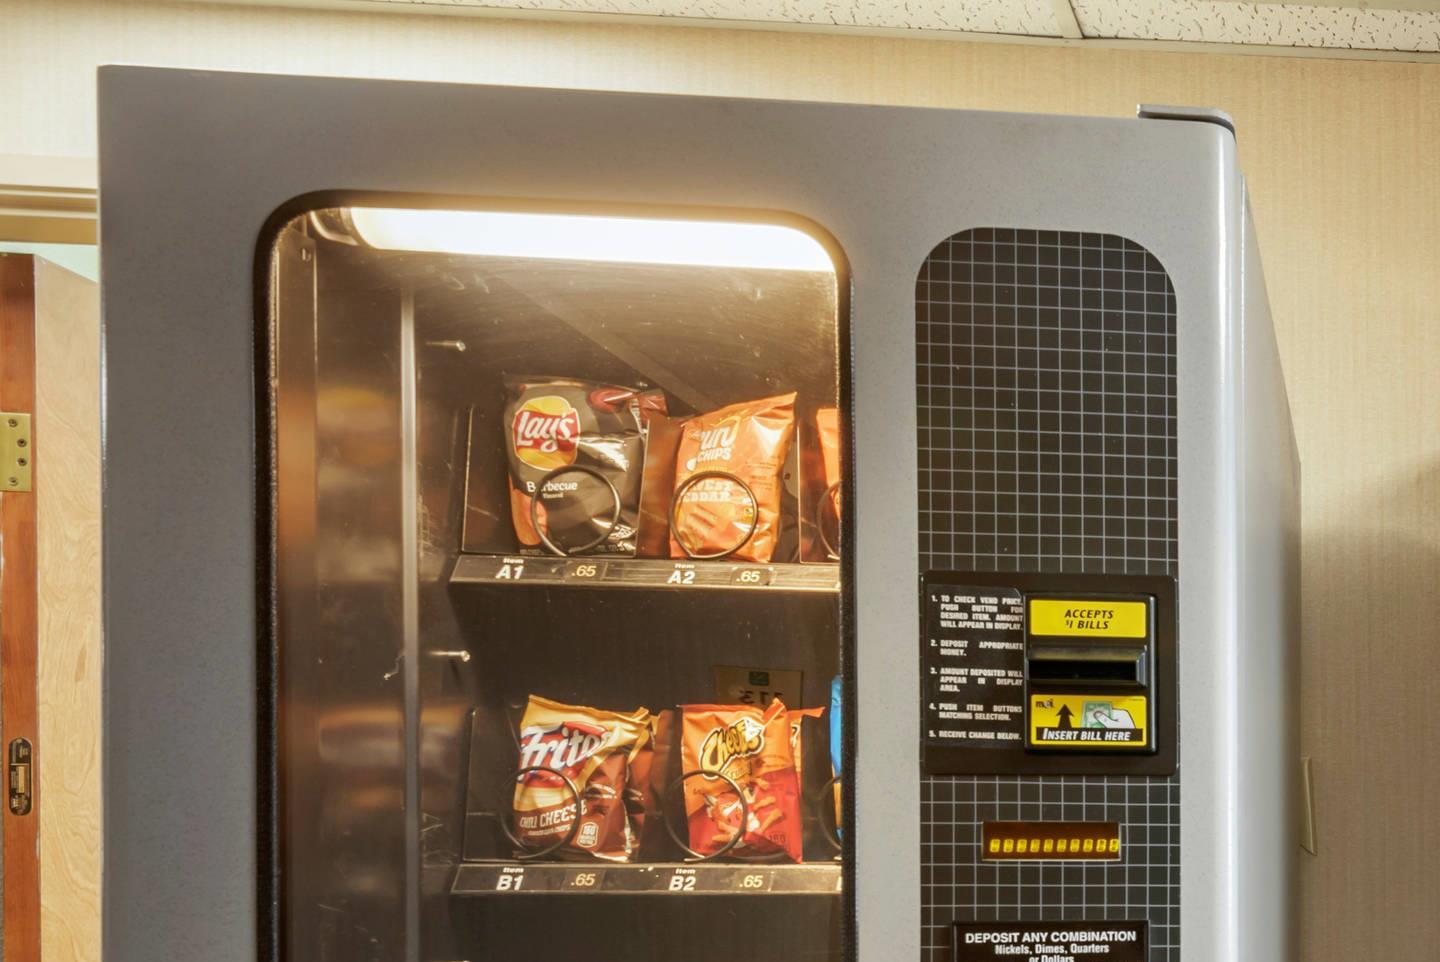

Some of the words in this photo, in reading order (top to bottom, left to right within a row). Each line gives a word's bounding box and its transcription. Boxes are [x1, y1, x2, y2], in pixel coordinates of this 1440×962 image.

[516, 411, 575, 453] Lay's
[526, 481, 578, 493] Brbecue
[495, 564, 523, 580] A1
[571, 565, 597, 577] .65
[667, 570, 695, 585] A2
[736, 570, 760, 583] .65
[954, 595, 976, 603] CHECK
[1064, 609, 1114, 619] ACCEPTS
[1066, 620, 1073, 630] $1
[1078, 620, 1109, 630] BILLS
[1042, 728, 1079, 740] INSERT
[1080, 731, 1102, 740] BILL
[1104, 731, 1132, 741] HERE
[496, 875, 523, 890] B1
[570, 873, 596, 886] .65
[668, 876, 696, 891] B2
[738, 874, 764, 888] .65
[965, 932, 1018, 944] DEPOSIT
[1022, 932, 1048, 942] ANY
[1050, 931, 1136, 942] COMBINATION
[995, 944, 1032, 955] Nickels,
[1035, 944, 1068, 954] Dimes,
[1070, 943, 1110, 954] Quarters
